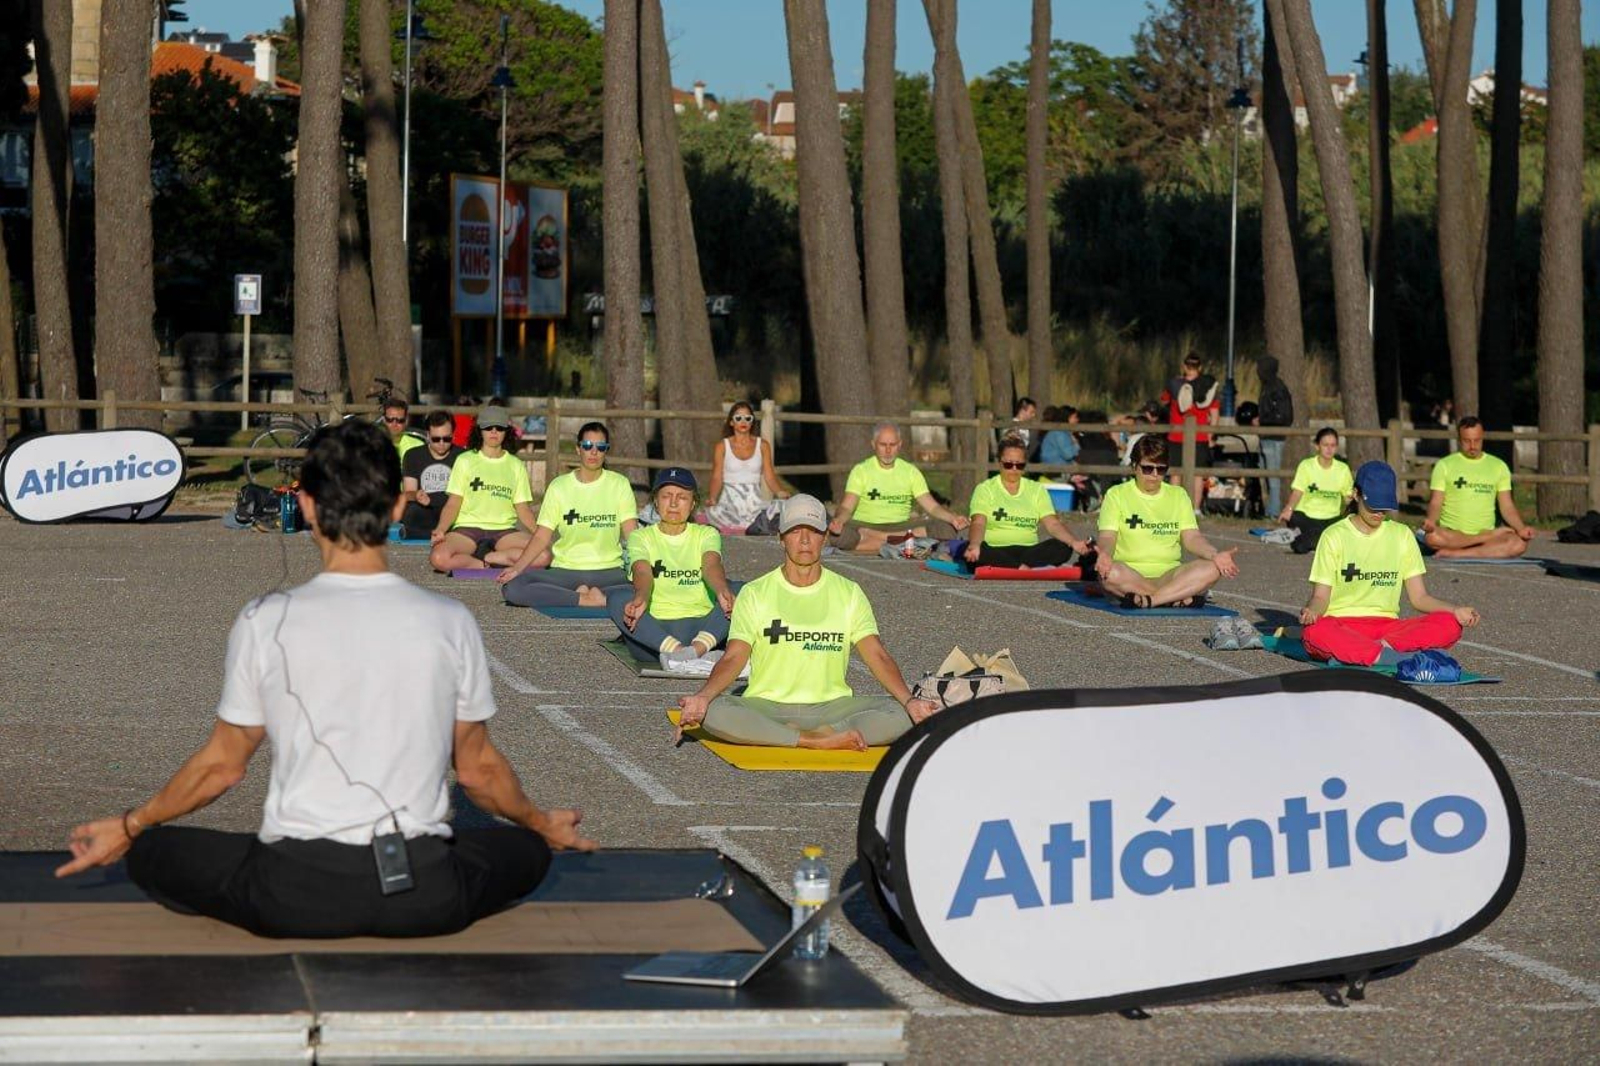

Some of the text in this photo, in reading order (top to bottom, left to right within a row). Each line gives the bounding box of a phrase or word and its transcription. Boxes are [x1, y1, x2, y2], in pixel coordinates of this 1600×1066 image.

[459, 225, 491, 245] BURGER
[459, 247, 491, 277] KING
[16, 454, 177, 499] Atlántico
[802, 642, 843, 652] Atlántico
[946, 776, 1488, 920] Atlántico
